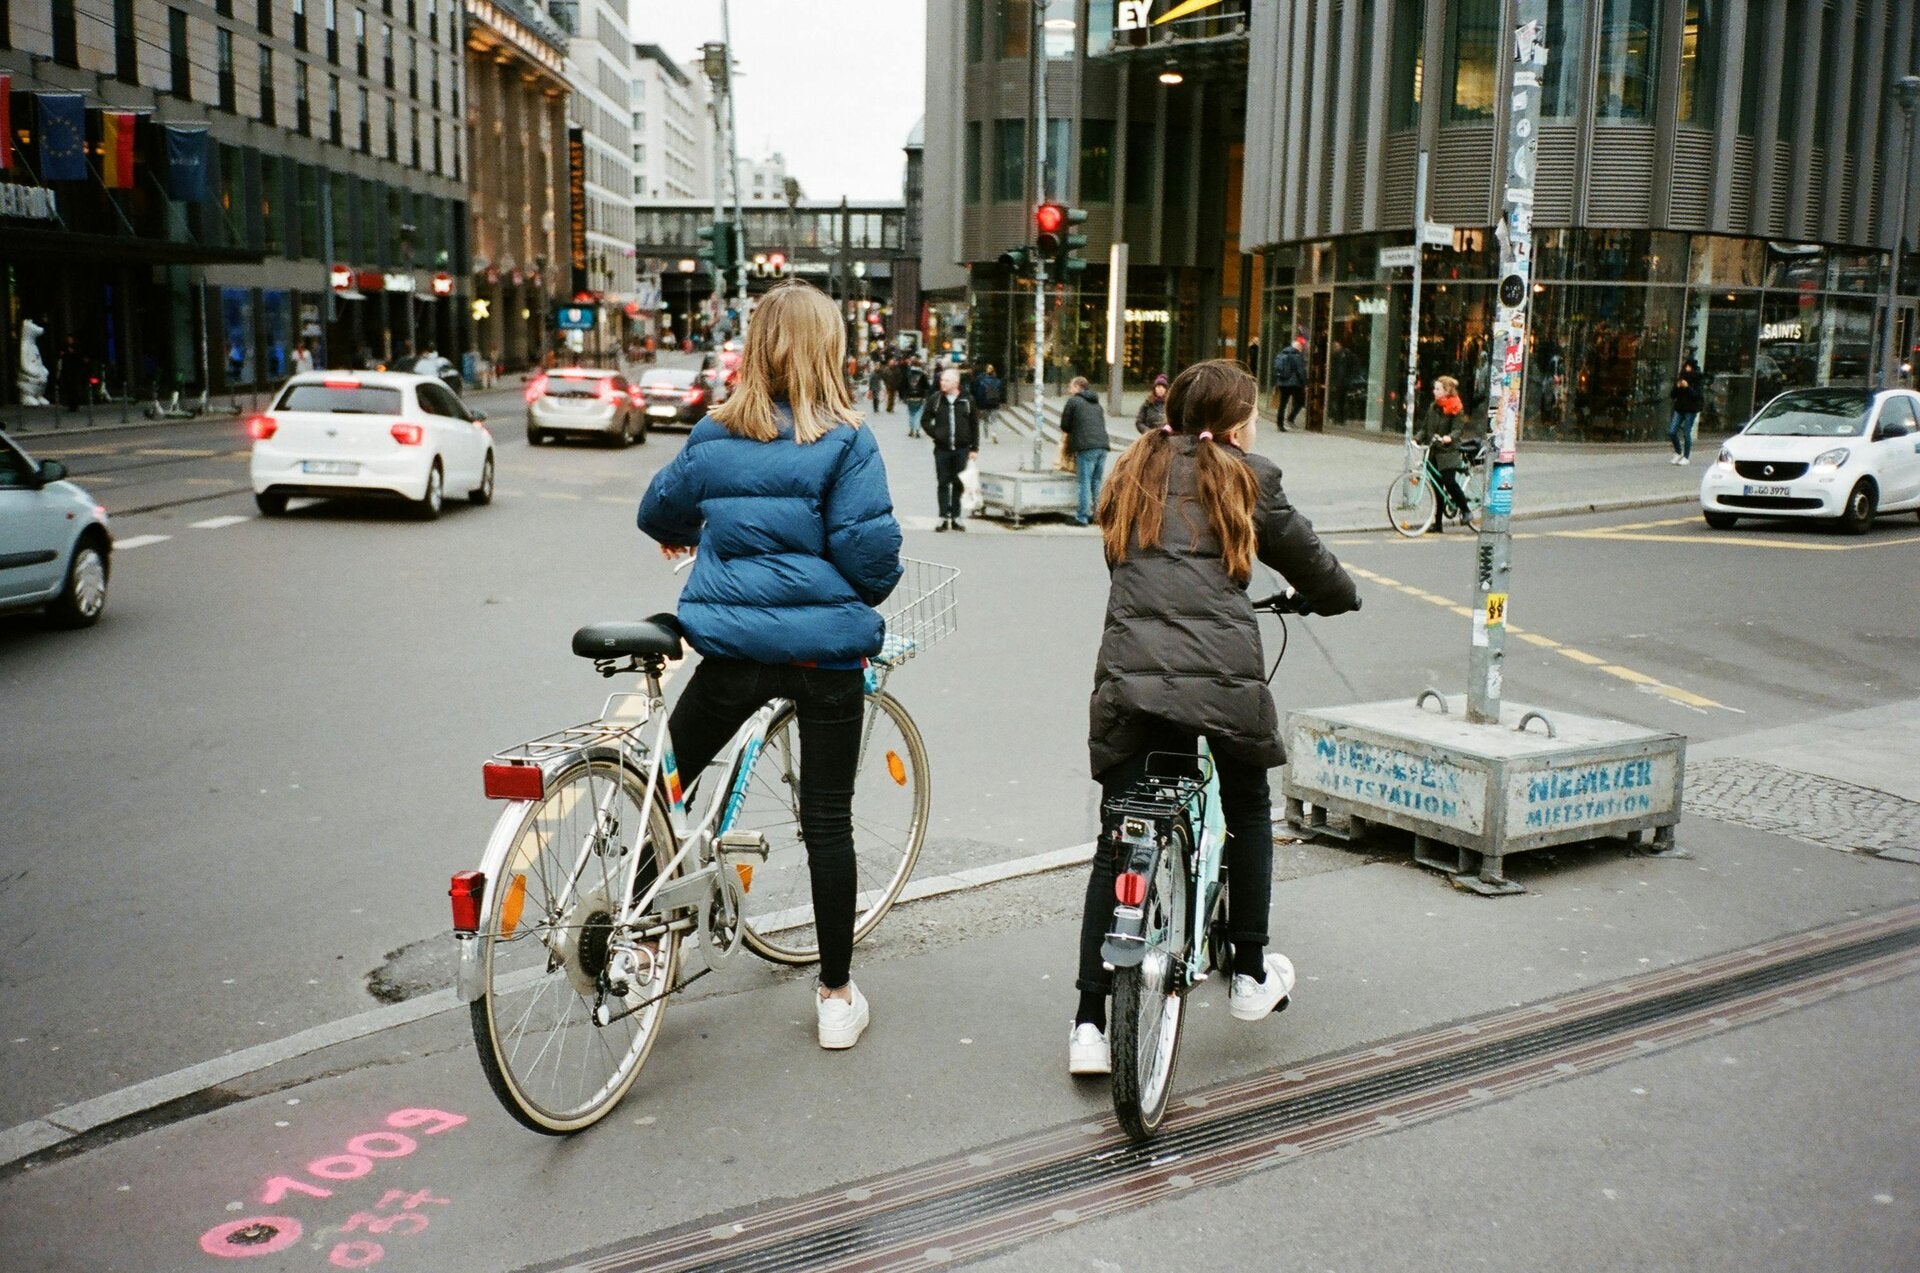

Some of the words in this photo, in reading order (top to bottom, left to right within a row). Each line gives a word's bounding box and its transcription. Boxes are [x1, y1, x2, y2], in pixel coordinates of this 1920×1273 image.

[1118, 0, 1153, 30] EY
[1526, 794, 1650, 827] MIETSTATION
[261, 1107, 469, 1205] 1009
